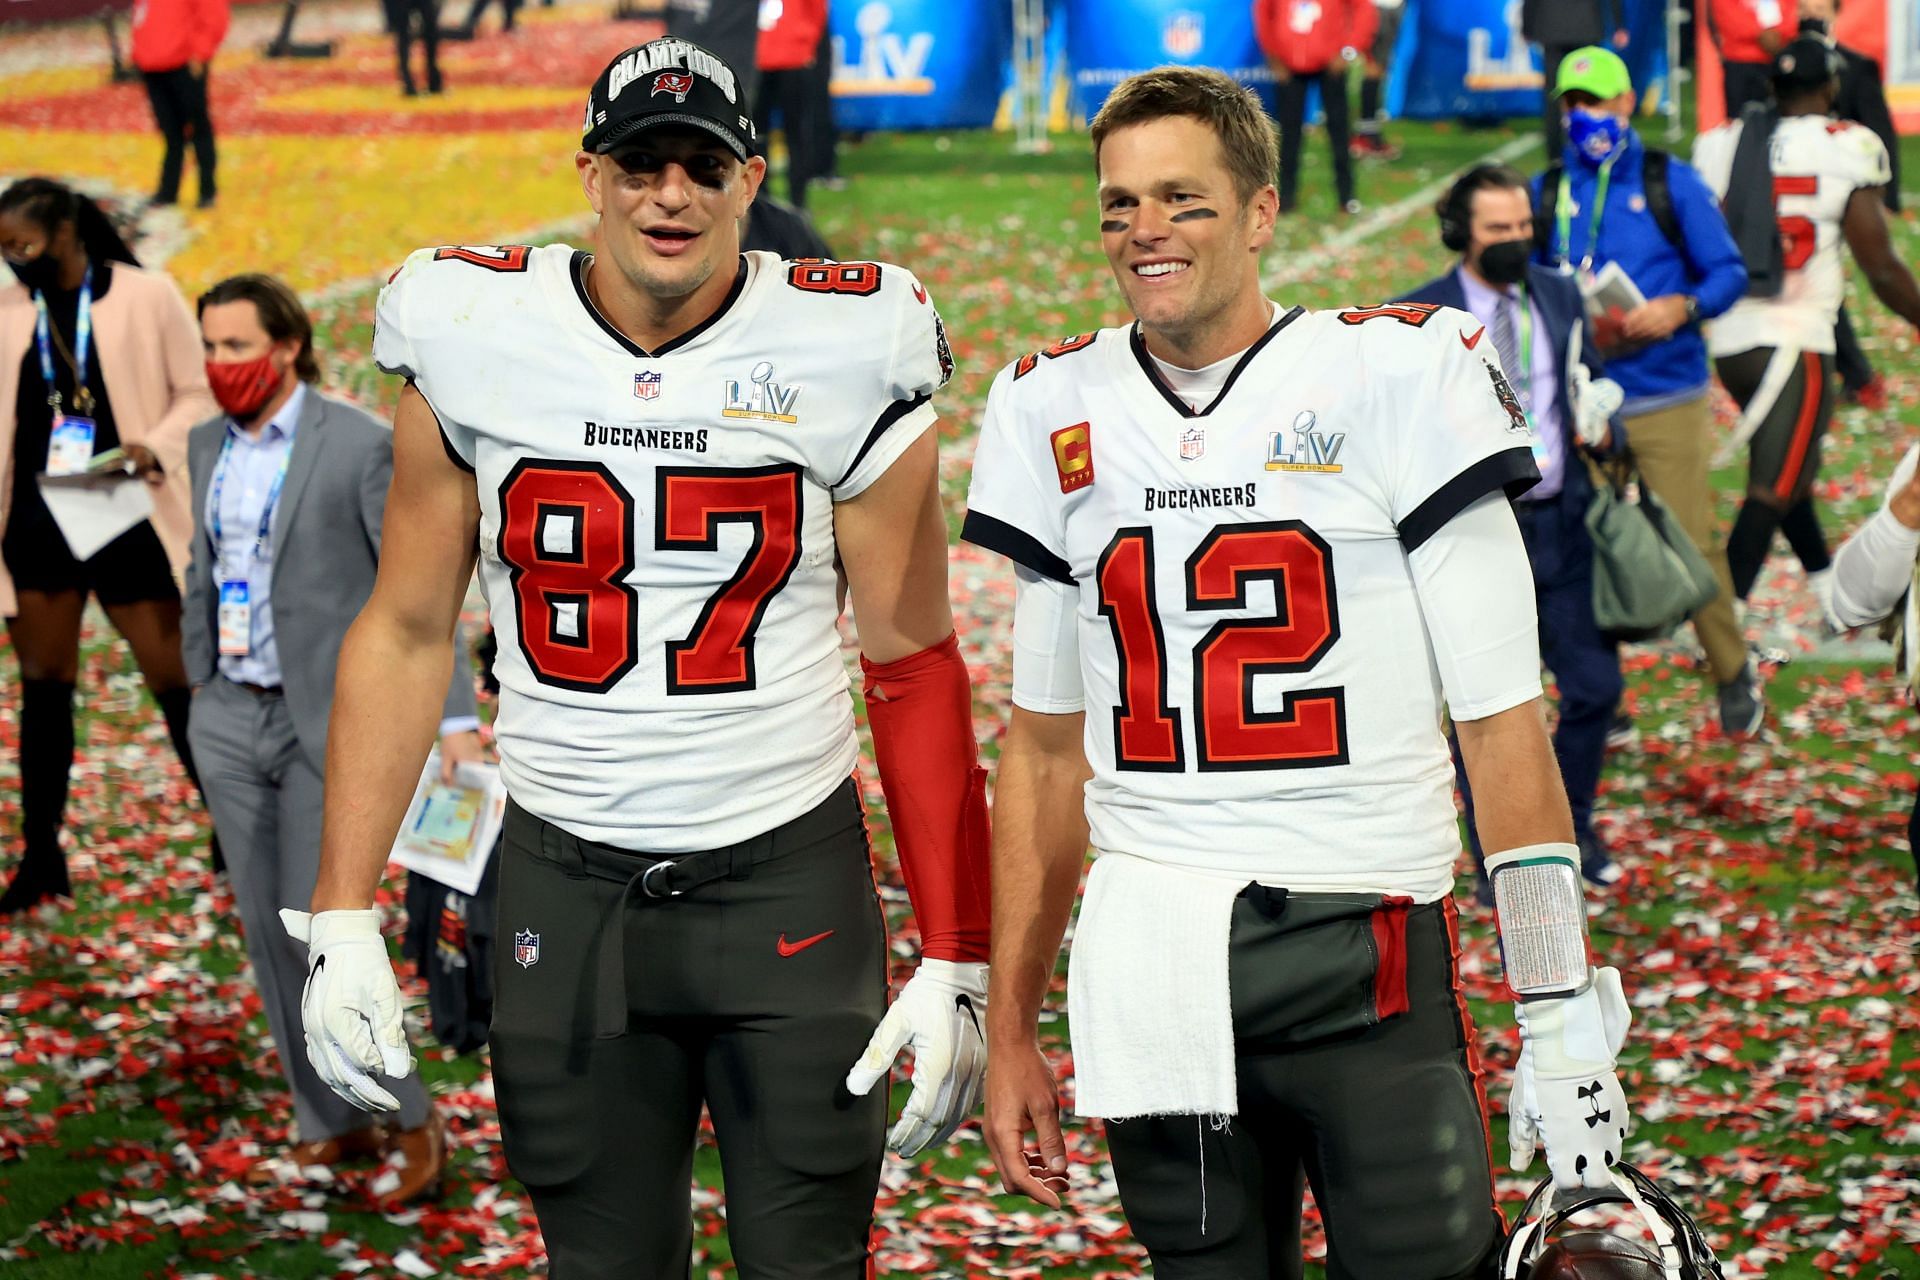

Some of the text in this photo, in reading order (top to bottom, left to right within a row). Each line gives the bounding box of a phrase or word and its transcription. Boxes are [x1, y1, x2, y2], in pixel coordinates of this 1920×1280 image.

[608, 42, 737, 105] CHAMPIONS
[636, 382, 658, 396] NFL
[584, 421, 708, 452] BUCCANEERS
[1055, 427, 1089, 474] C
[1144, 482, 1256, 513] BUCCANEERS
[497, 456, 804, 696] 87
[1096, 519, 1350, 773] 12
[517, 945, 536, 961] NFL
